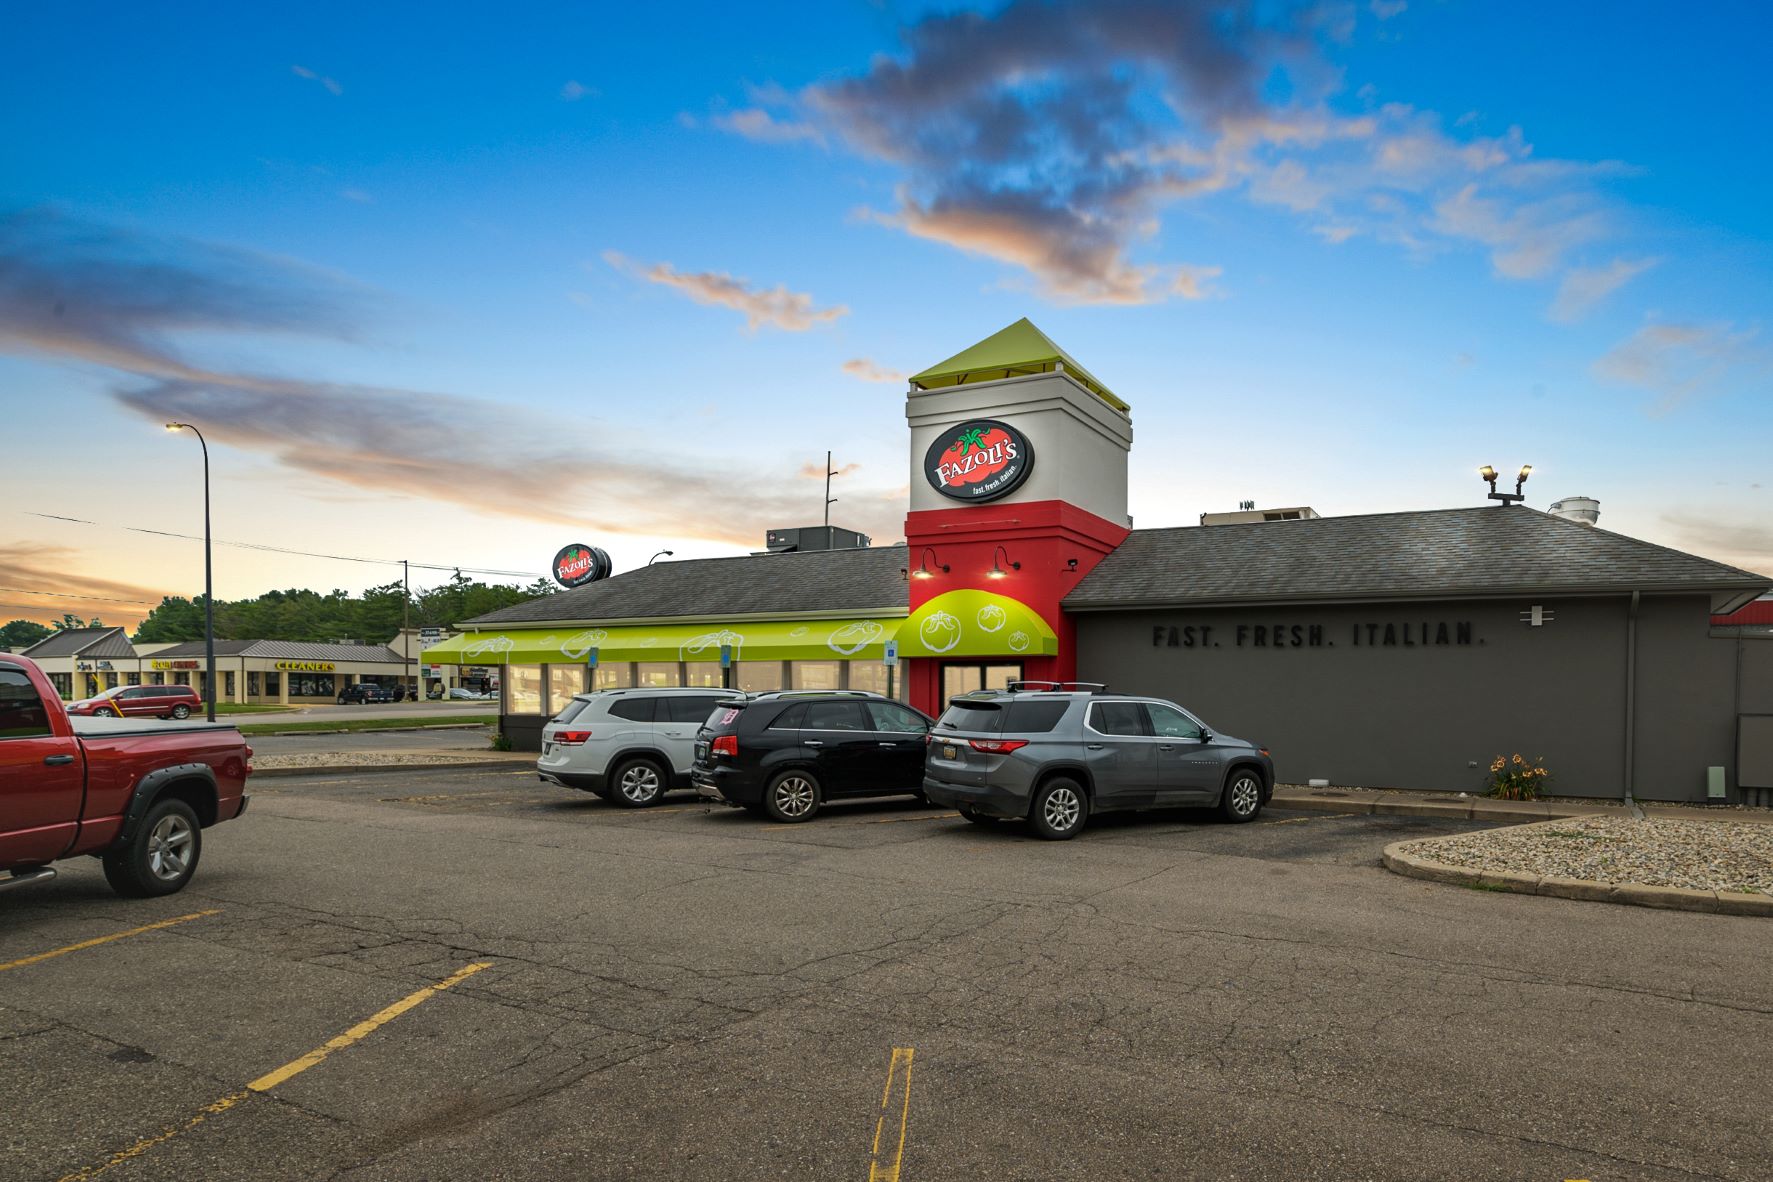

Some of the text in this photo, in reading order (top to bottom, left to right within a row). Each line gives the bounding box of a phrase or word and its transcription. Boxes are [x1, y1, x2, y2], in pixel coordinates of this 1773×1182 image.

[1152, 621, 1485, 647] FAST. FRESH. ITALIAN.
[275, 660, 336, 671] CLEANERS
